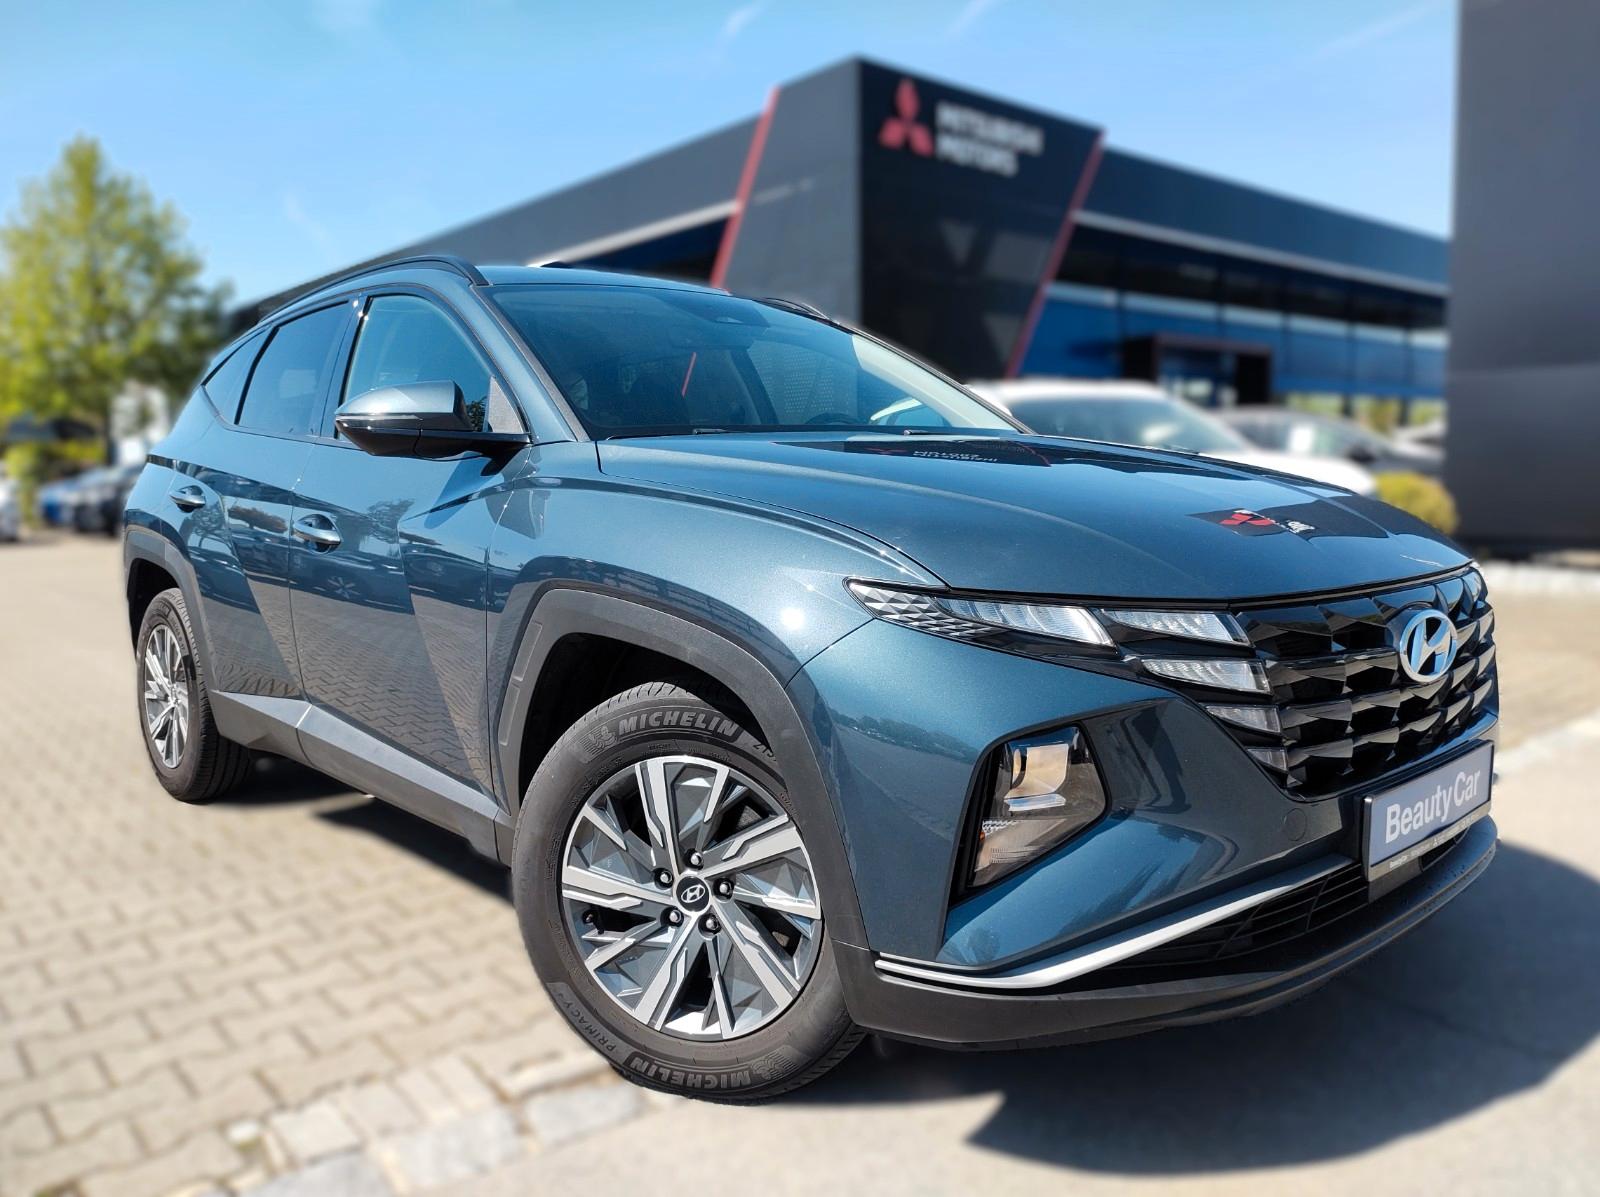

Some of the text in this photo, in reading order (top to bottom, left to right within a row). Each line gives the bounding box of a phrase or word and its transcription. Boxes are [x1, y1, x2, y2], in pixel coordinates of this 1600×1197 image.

[618, 710, 739, 737] MICHELIN
[563, 1000, 617, 1052] PRIMACY
[630, 1056, 751, 1089] MICHELIN
